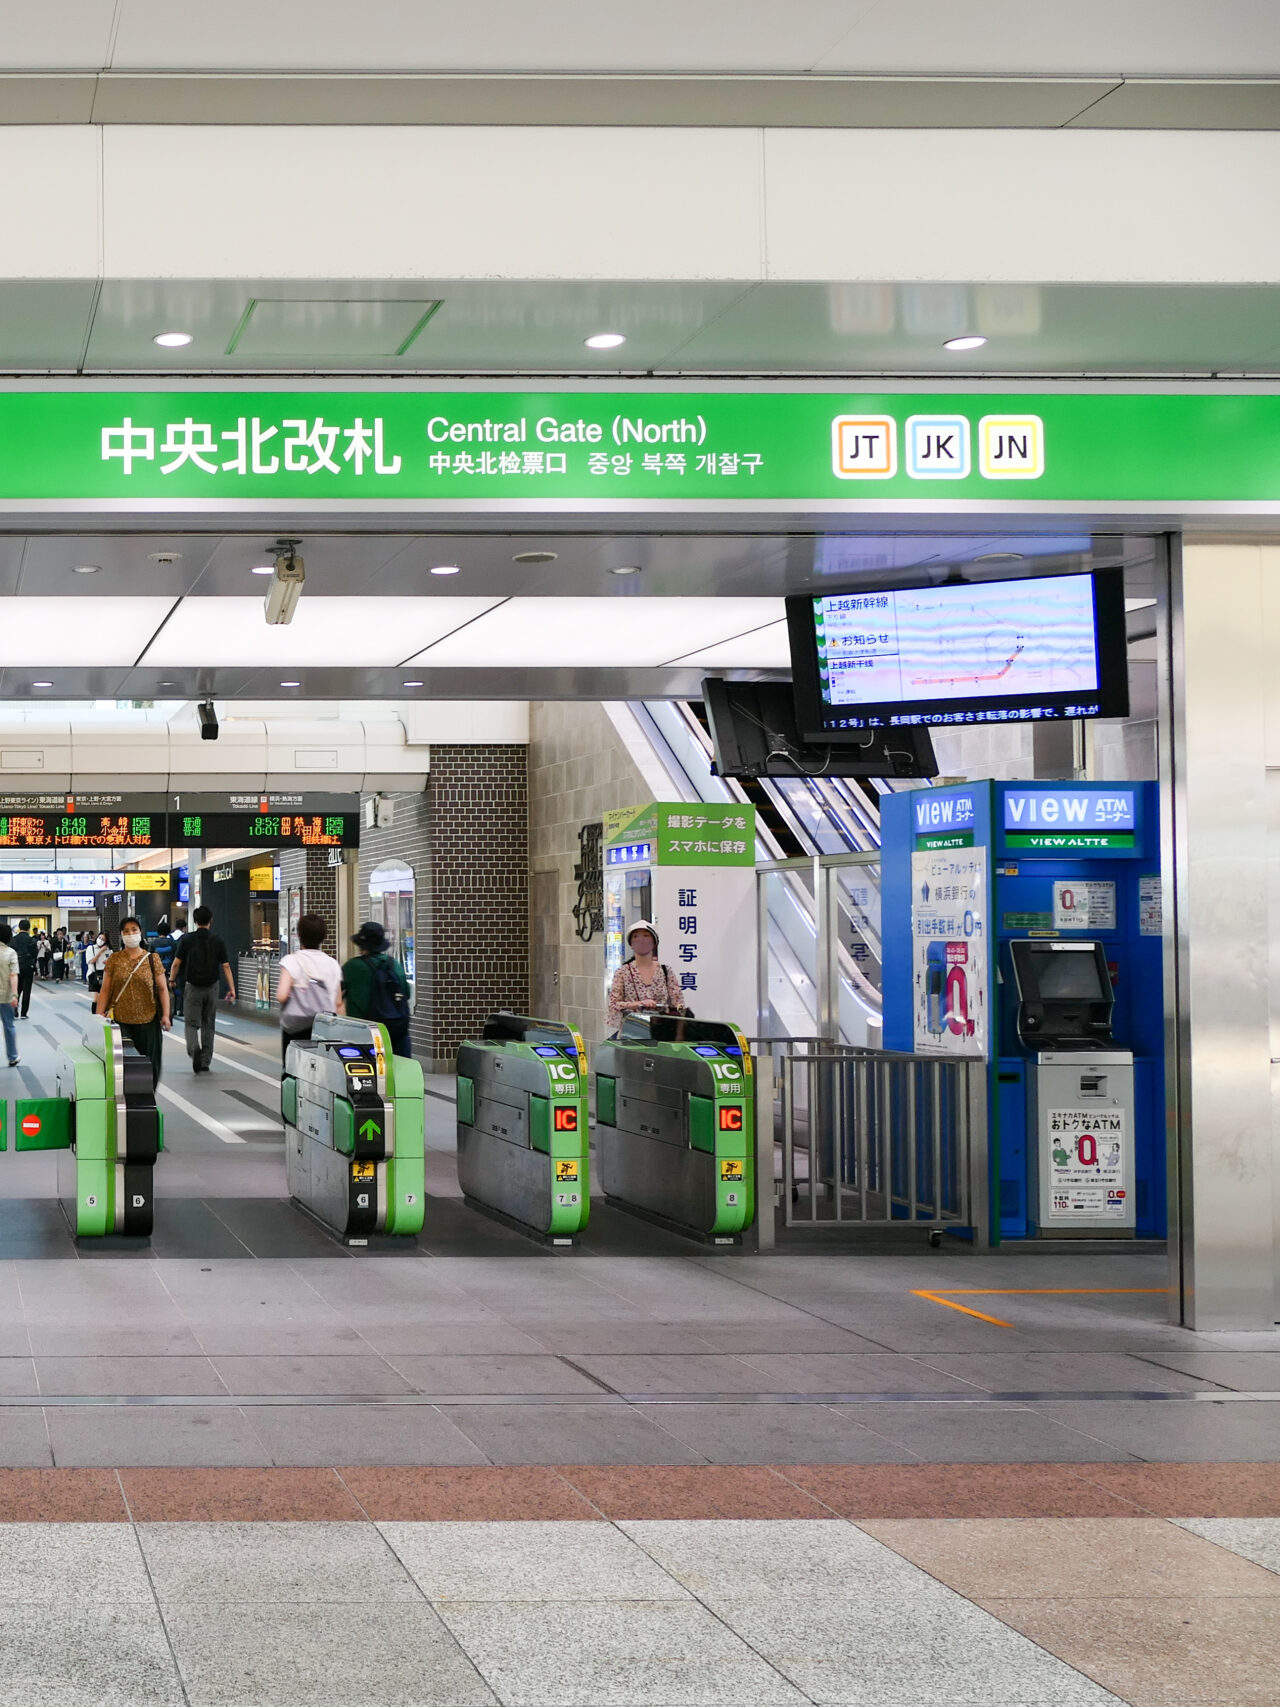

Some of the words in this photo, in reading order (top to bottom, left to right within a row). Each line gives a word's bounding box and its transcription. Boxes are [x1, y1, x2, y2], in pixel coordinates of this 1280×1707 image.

[427, 417, 526, 443] Central
[535, 417, 603, 443] Gate
[612, 415, 707, 446] (North)
[99, 415, 401, 476] 中央北改札
[850, 435, 879, 459] JT
[922, 435, 954, 459] JK
[994, 435, 1027, 459] JN
[428, 451, 567, 475] 中央北检票口
[587, 452, 634, 476] 중앙
[641, 452, 687, 476] 북쪽
[695, 452, 765, 476] 개찰구
[826, 597, 889, 612] 上越新幹線
[841, 634, 889, 647] お知らせ
[173, 796, 180, 811] 1
[955, 798, 973, 811] ATM
[1095, 799, 1128, 811] ATM
[61, 817, 86, 827] 9:49
[255, 817, 280, 827] 9:52
[667, 815, 746, 829] 撮影データを
[955, 811, 975, 821] コーナー
[1095, 811, 1131, 821] コーナー
[55, 827, 86, 836] 10:00
[248, 826, 279, 836] 10:01
[668, 840, 746, 854] スマホに保存
[678, 888, 698, 991] 証明写真
[549, 1063, 576, 1080] IC
[713, 1063, 741, 1080] IC
[554, 1084, 576, 1094] 専用
[720, 1084, 741, 1094] 専用
[556, 1110, 577, 1130] IC
[721, 1109, 742, 1129] IC
[1051, 1119, 1121, 1130] おトクなATM
